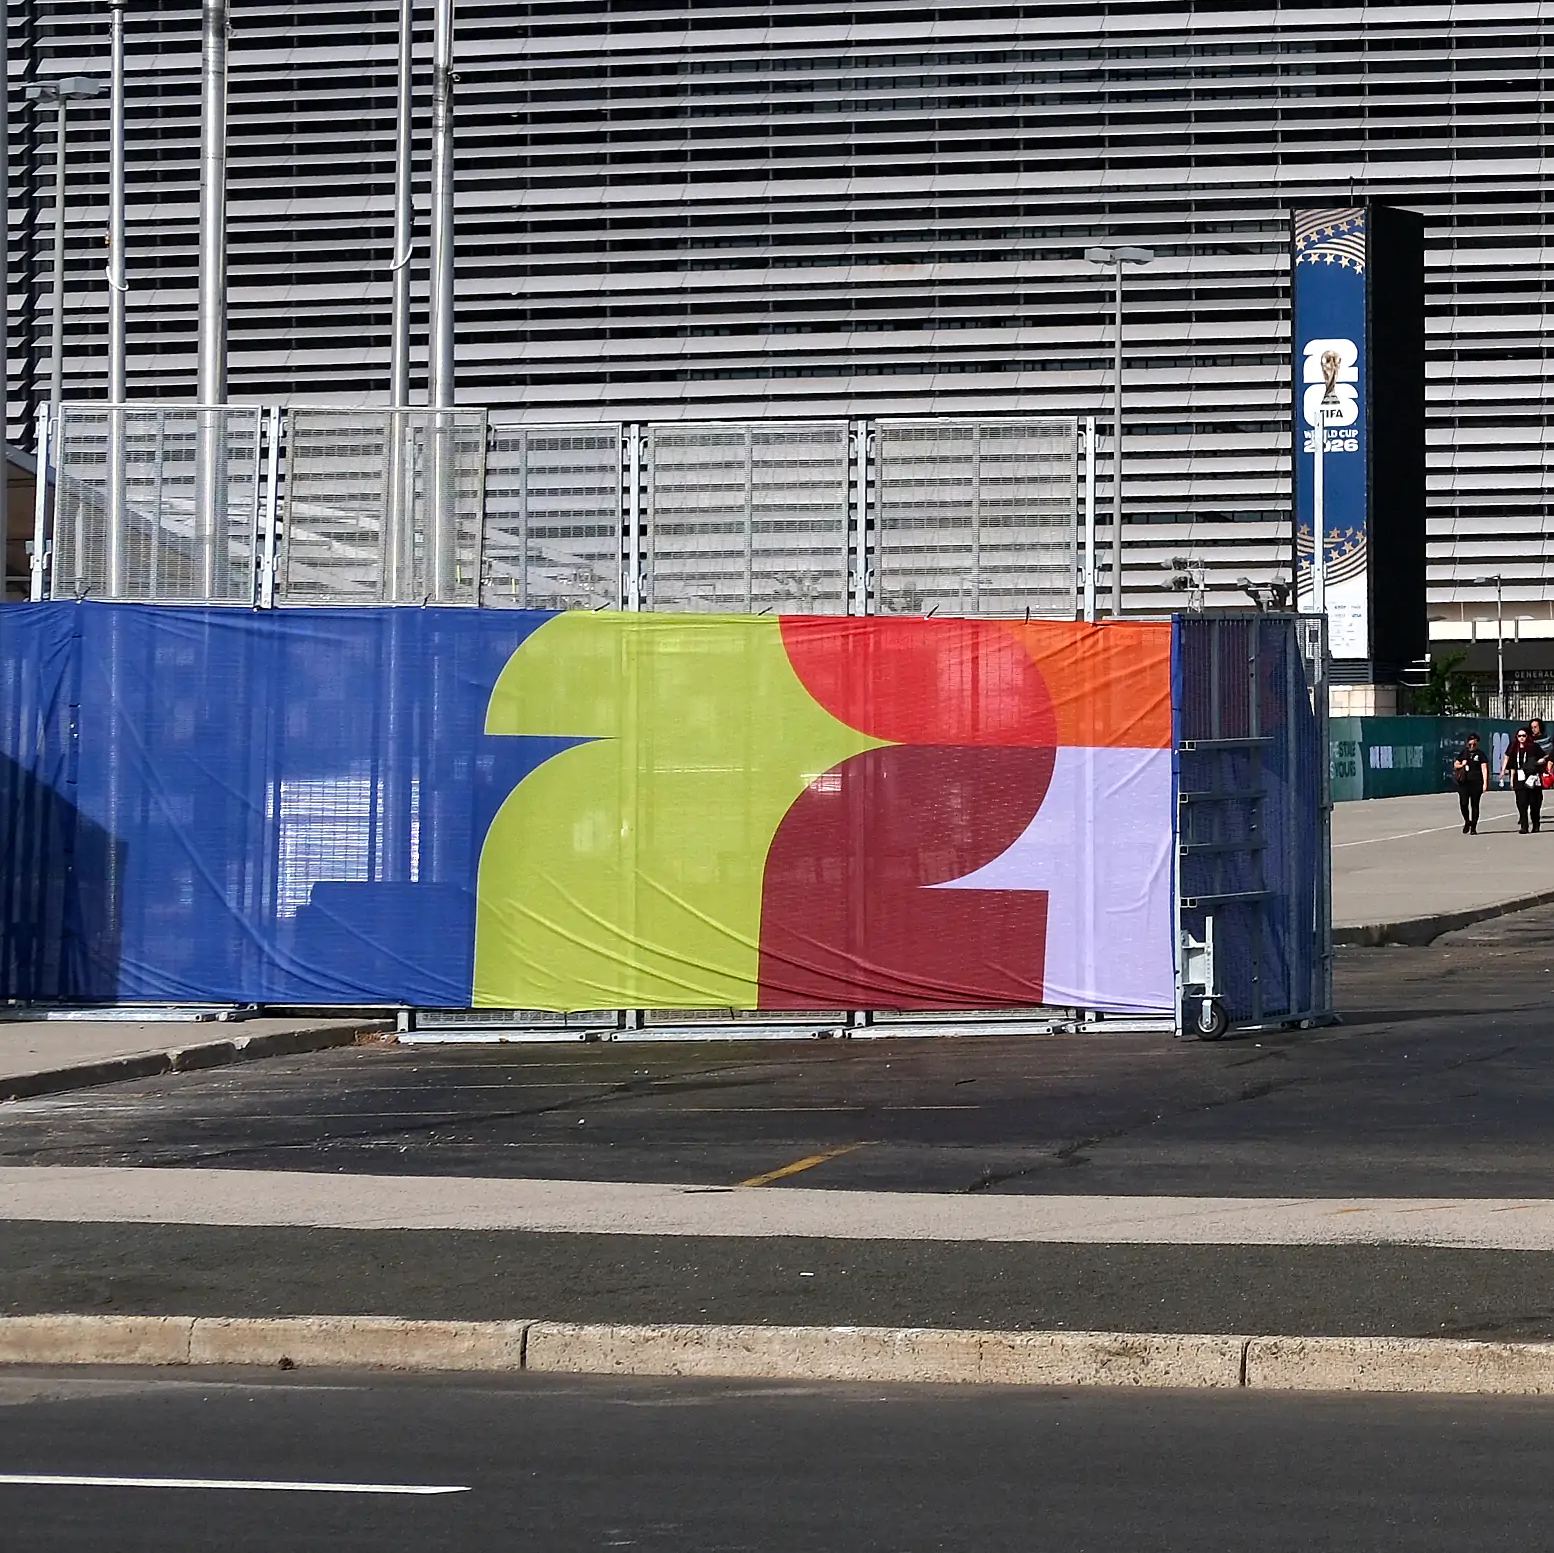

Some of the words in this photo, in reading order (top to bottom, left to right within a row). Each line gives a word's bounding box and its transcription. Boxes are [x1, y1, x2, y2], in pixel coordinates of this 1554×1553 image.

[1303, 429, 1338, 439] WLD
[1338, 429, 1359, 439] CUP
[1514, 670, 1554, 679] GENERAL
